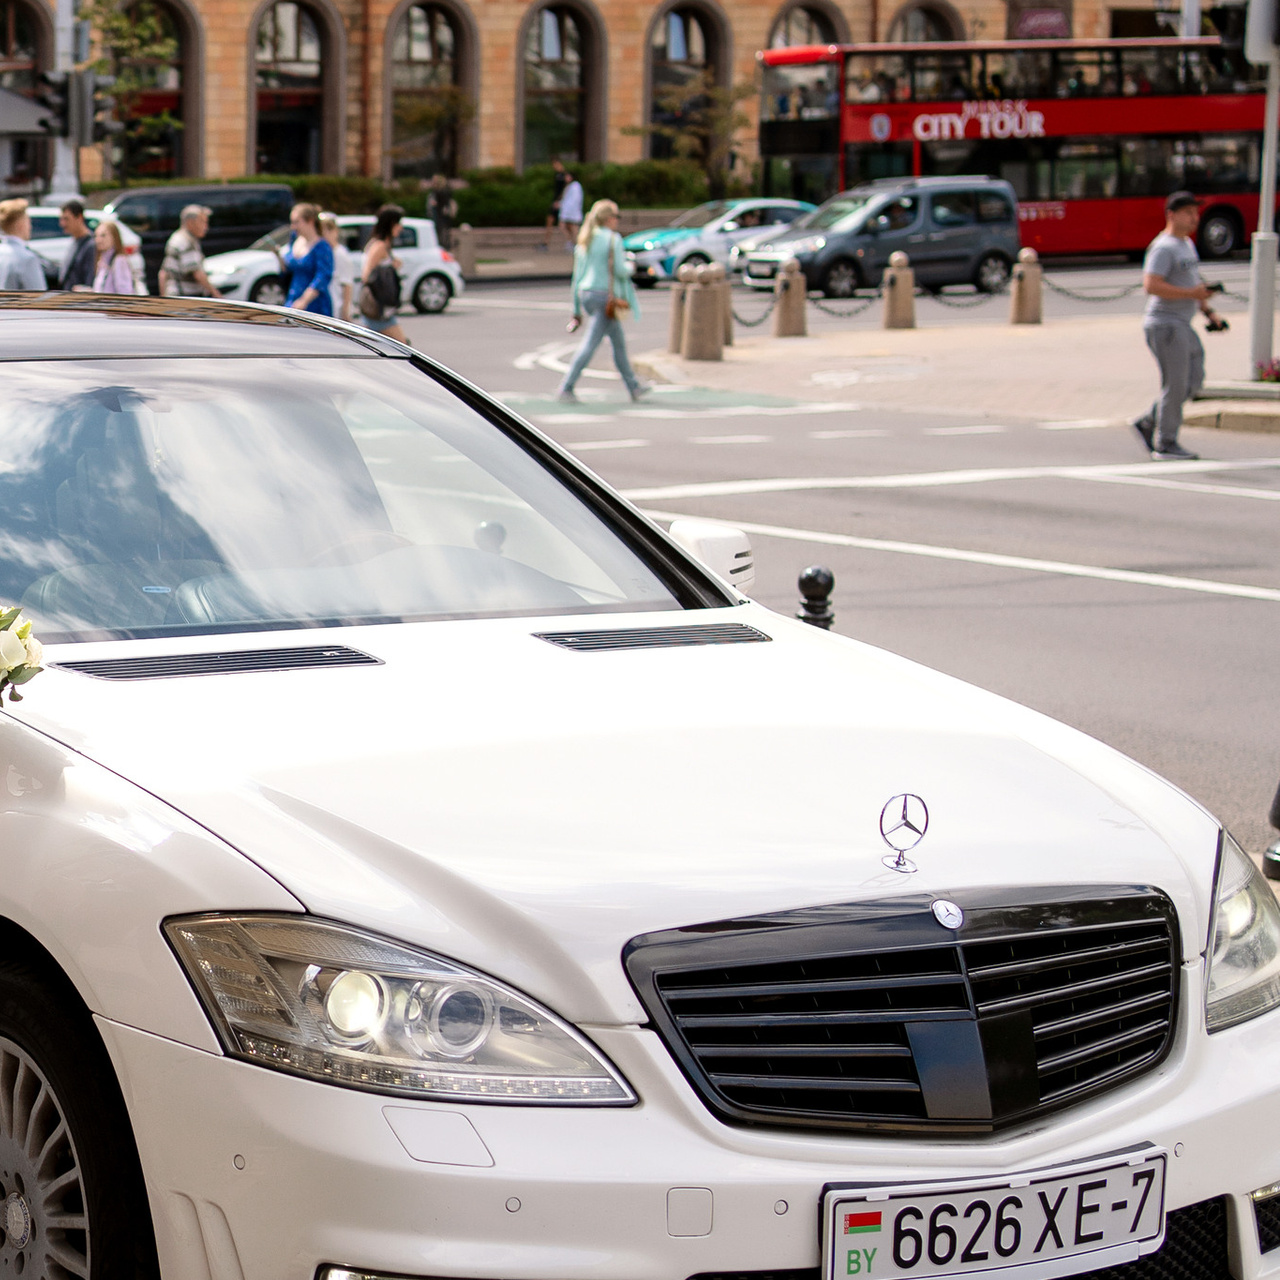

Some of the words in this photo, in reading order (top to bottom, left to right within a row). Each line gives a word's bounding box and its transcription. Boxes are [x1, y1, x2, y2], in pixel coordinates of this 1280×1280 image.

[913, 112, 968, 140] CITY
[977, 111, 1046, 139] TOUR
[892, 1195, 1024, 1269] 6626
[1033, 1168, 1156, 1253] XE-7
[846, 1247, 878, 1275] BY
